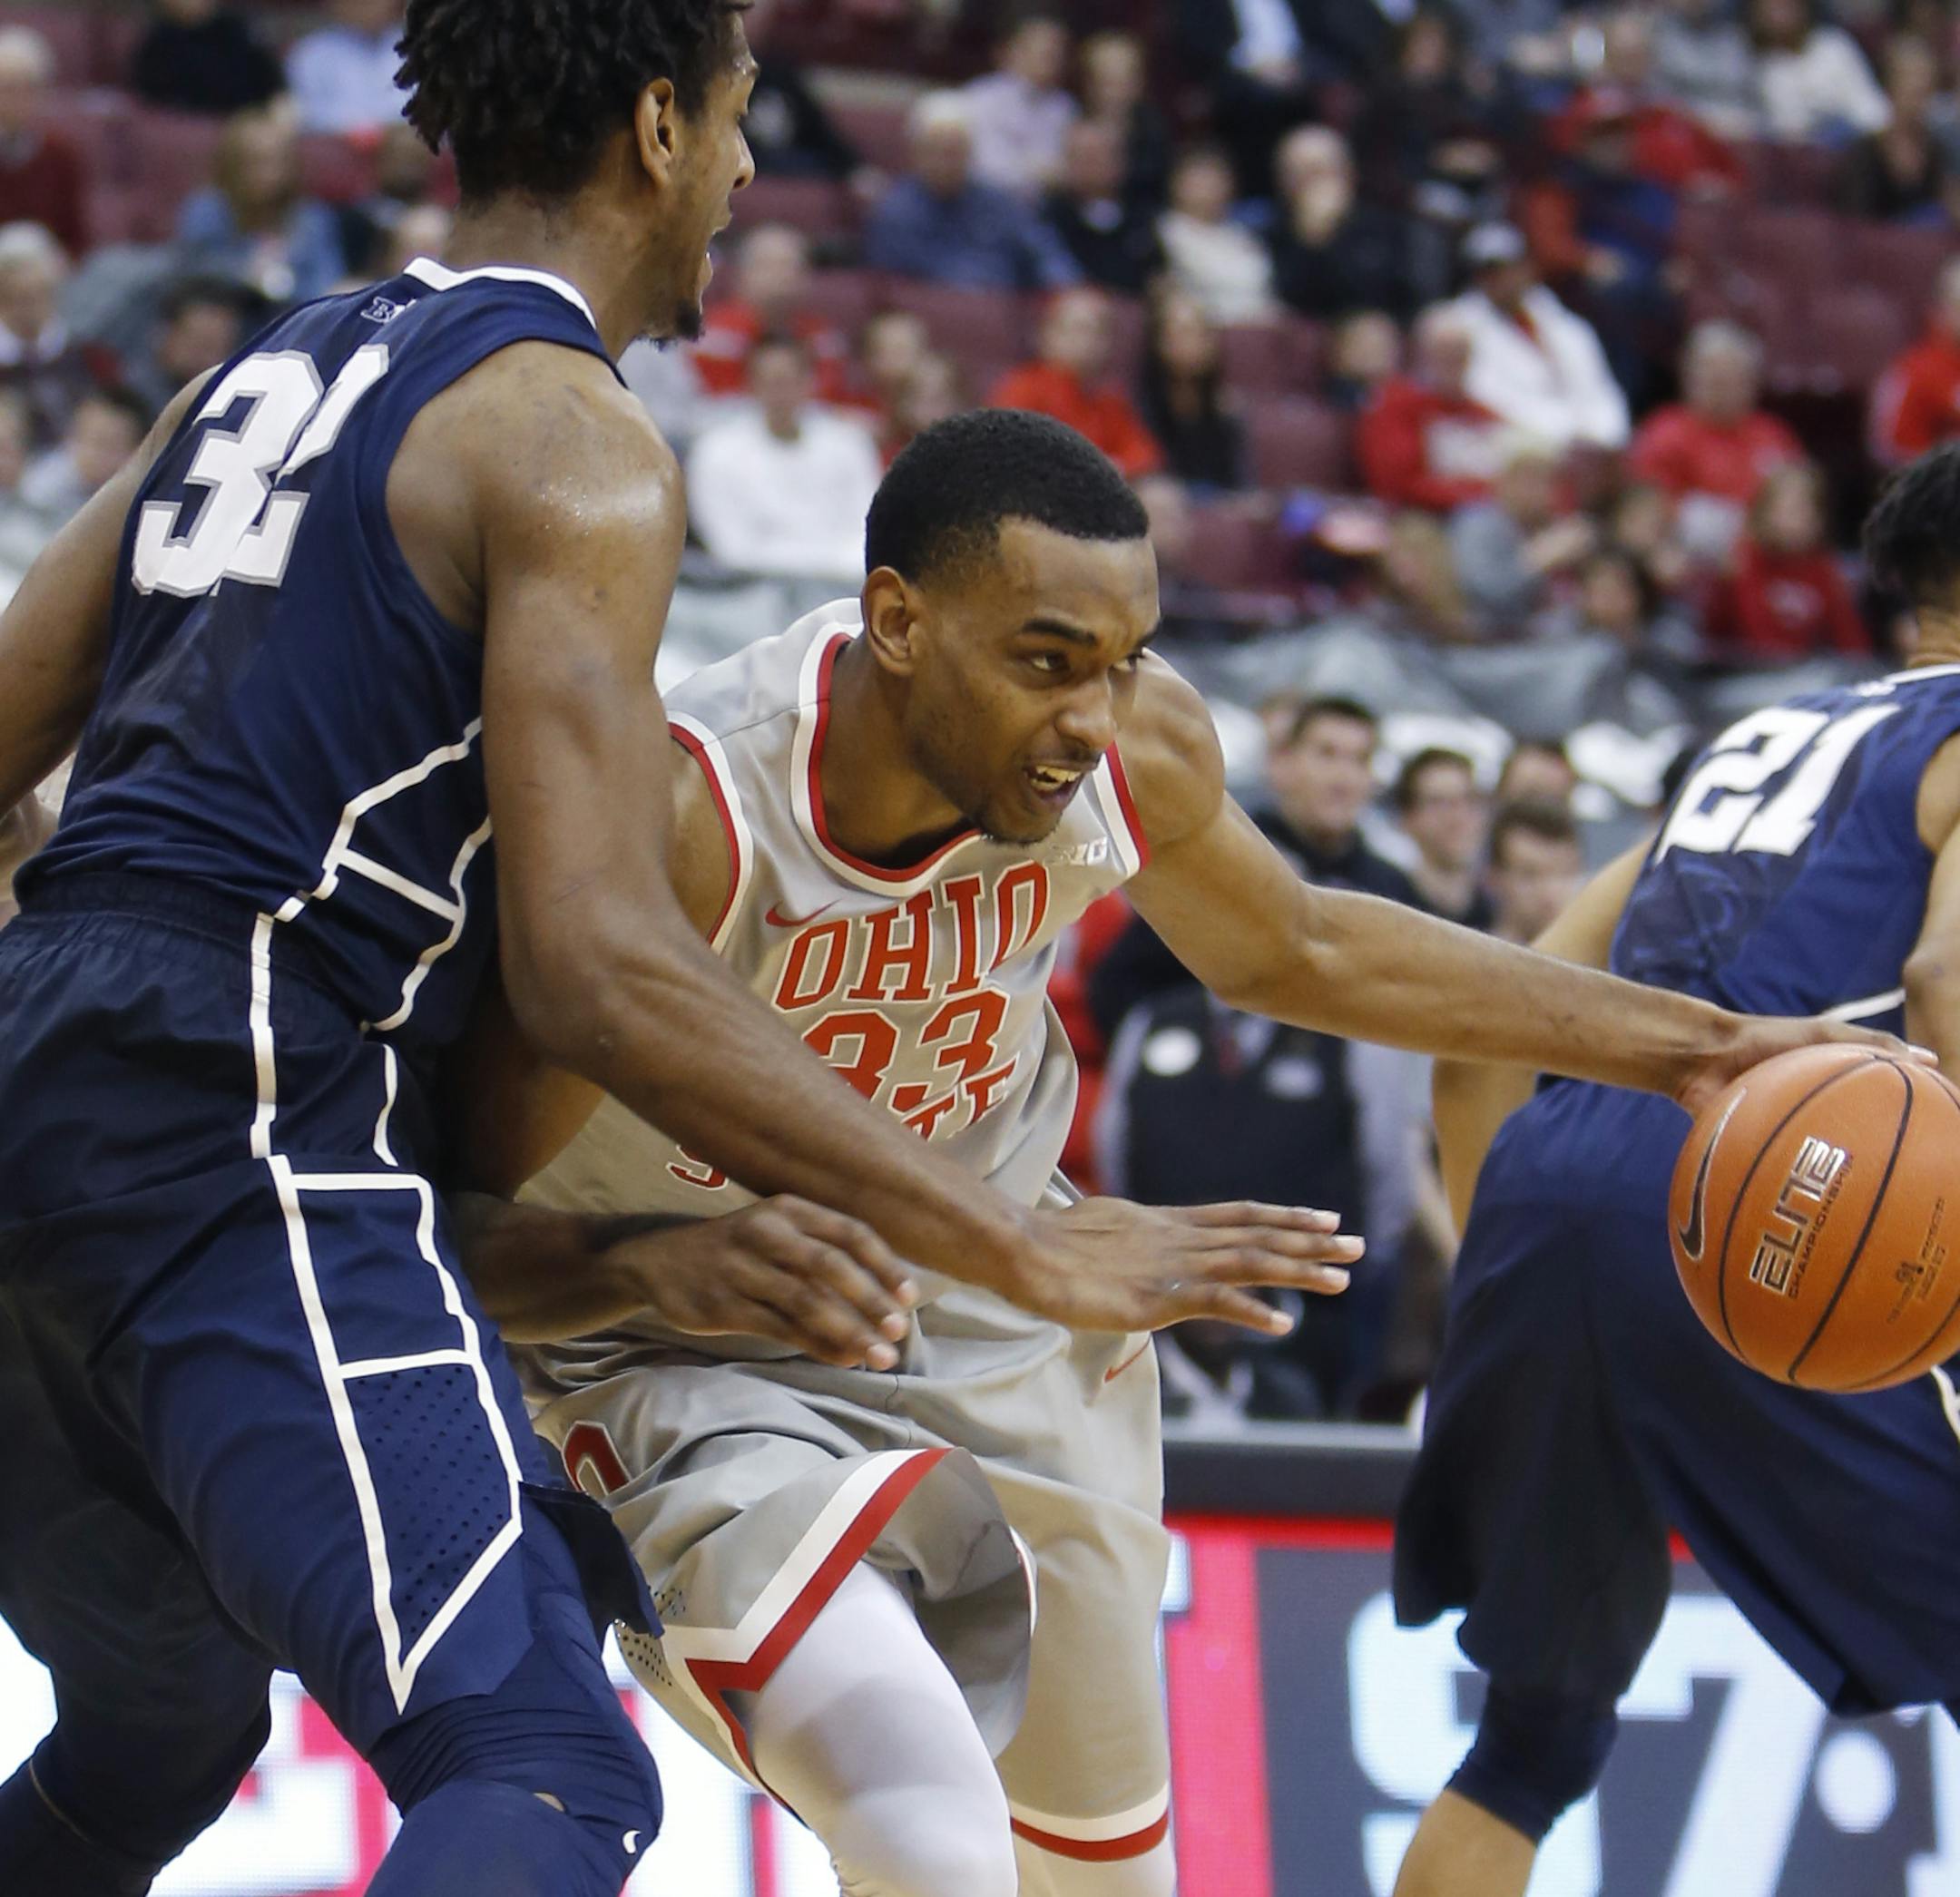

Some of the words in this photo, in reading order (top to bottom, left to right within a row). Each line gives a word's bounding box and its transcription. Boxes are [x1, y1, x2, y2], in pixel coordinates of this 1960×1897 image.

[132, 343, 389, 599] 32
[1653, 702, 1902, 864] 21
[771, 859, 1051, 1012] OHIO
[801, 989, 1011, 1115] 33
[1749, 1136, 1846, 1295] ELITE
[1788, 1152, 1855, 1300] CHAMPIONSHIP
